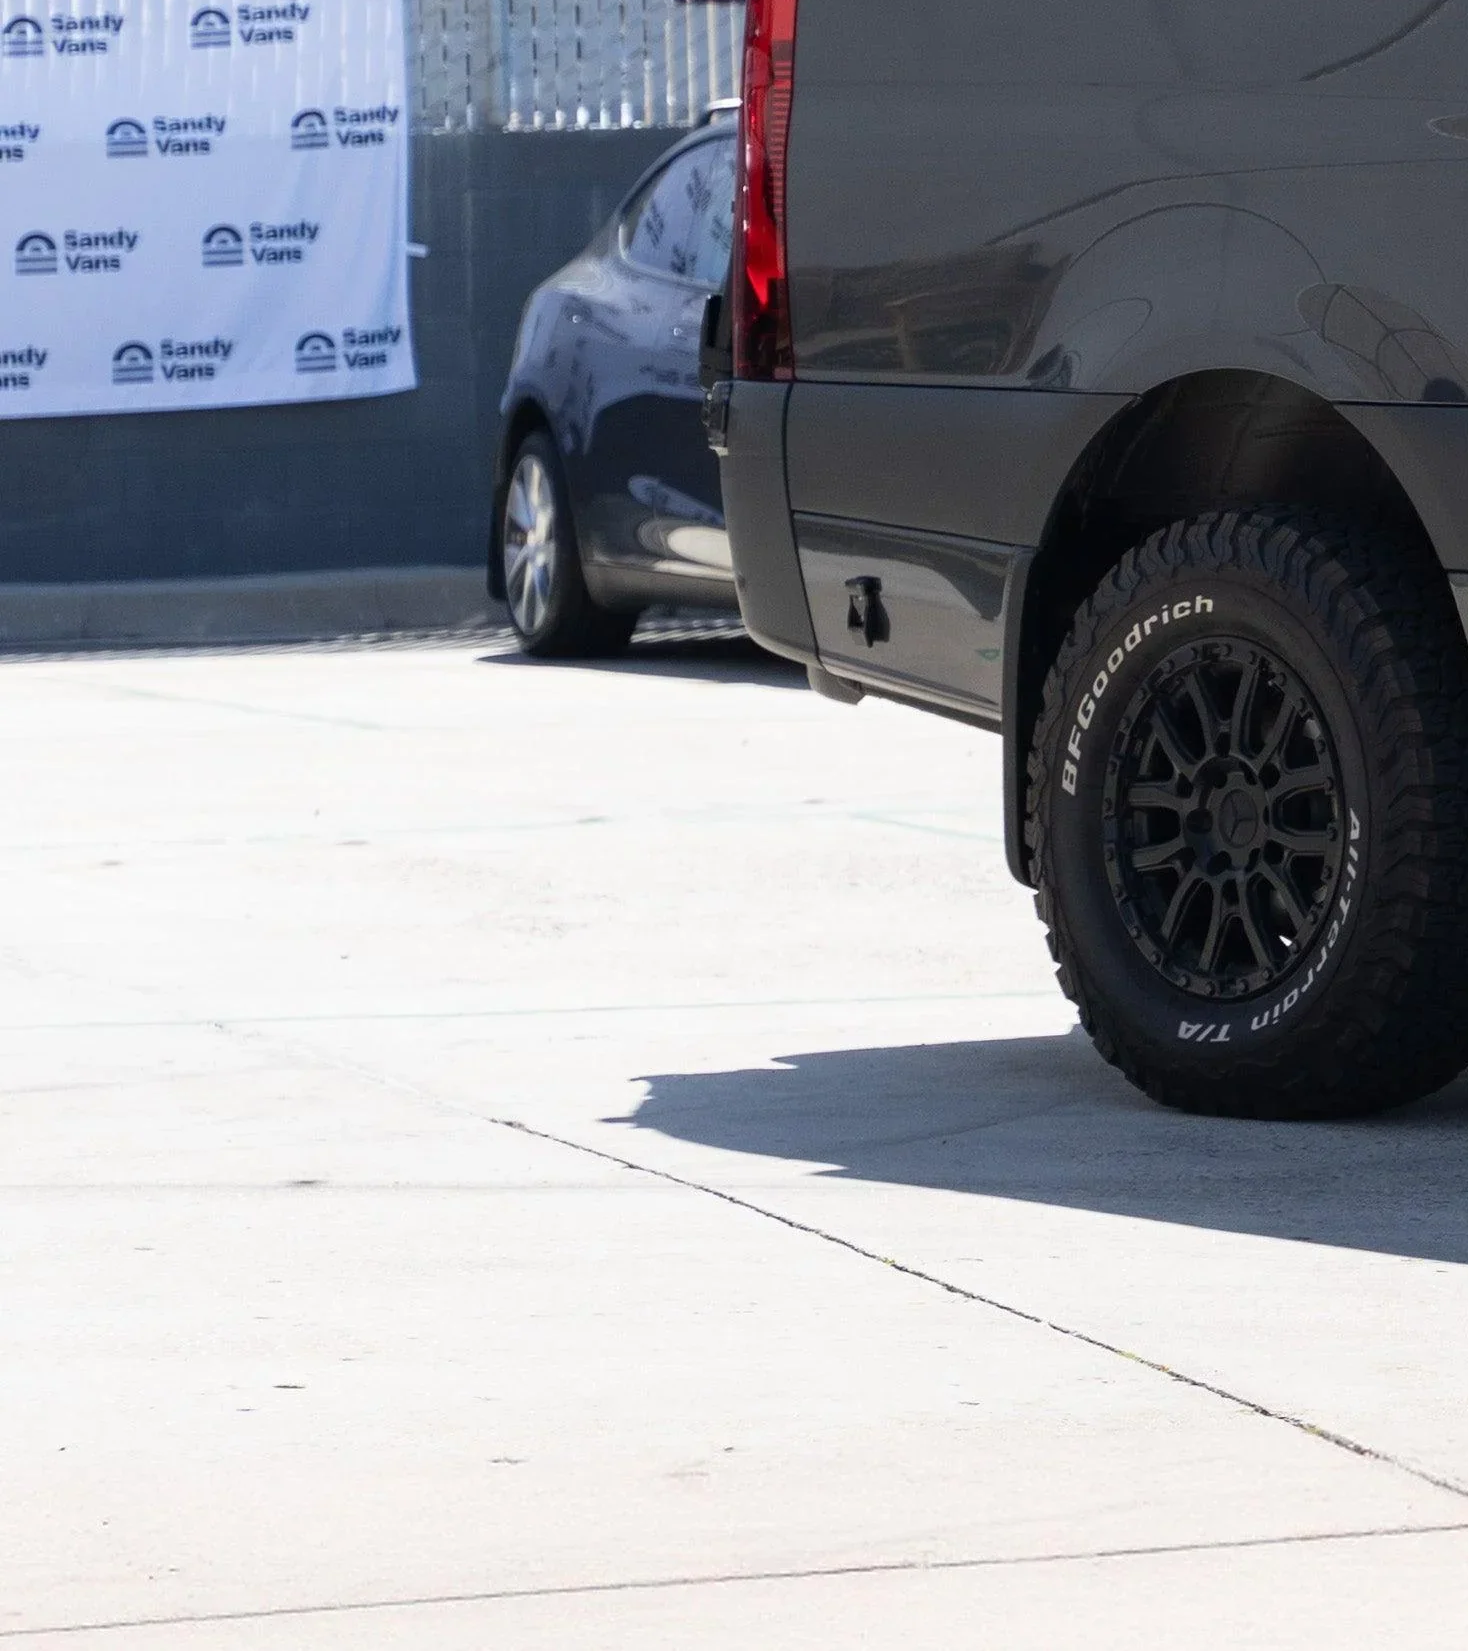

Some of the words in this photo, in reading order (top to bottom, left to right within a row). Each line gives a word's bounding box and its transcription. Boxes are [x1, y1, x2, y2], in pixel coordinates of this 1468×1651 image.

[236, 0, 310, 22] Sandy
[50, 12, 124, 33] Sandy
[52, 36, 107, 55] Vans
[238, 26, 294, 45] Vans
[152, 112, 226, 134] Sandy
[332, 104, 399, 126] Sandy
[154, 137, 211, 156] Vans
[335, 128, 385, 147] Vans
[63, 228, 138, 251] Sandy
[248, 219, 320, 242] Sandy
[65, 253, 121, 272] Vans
[249, 245, 303, 265] Vans
[159, 336, 234, 360] Sandy
[160, 361, 216, 381] Vans
[1060, 594, 1215, 797] BFGoodrich
[1250, 807, 1362, 1032] All-Terrain
[1176, 1020, 1233, 1045] T/A
